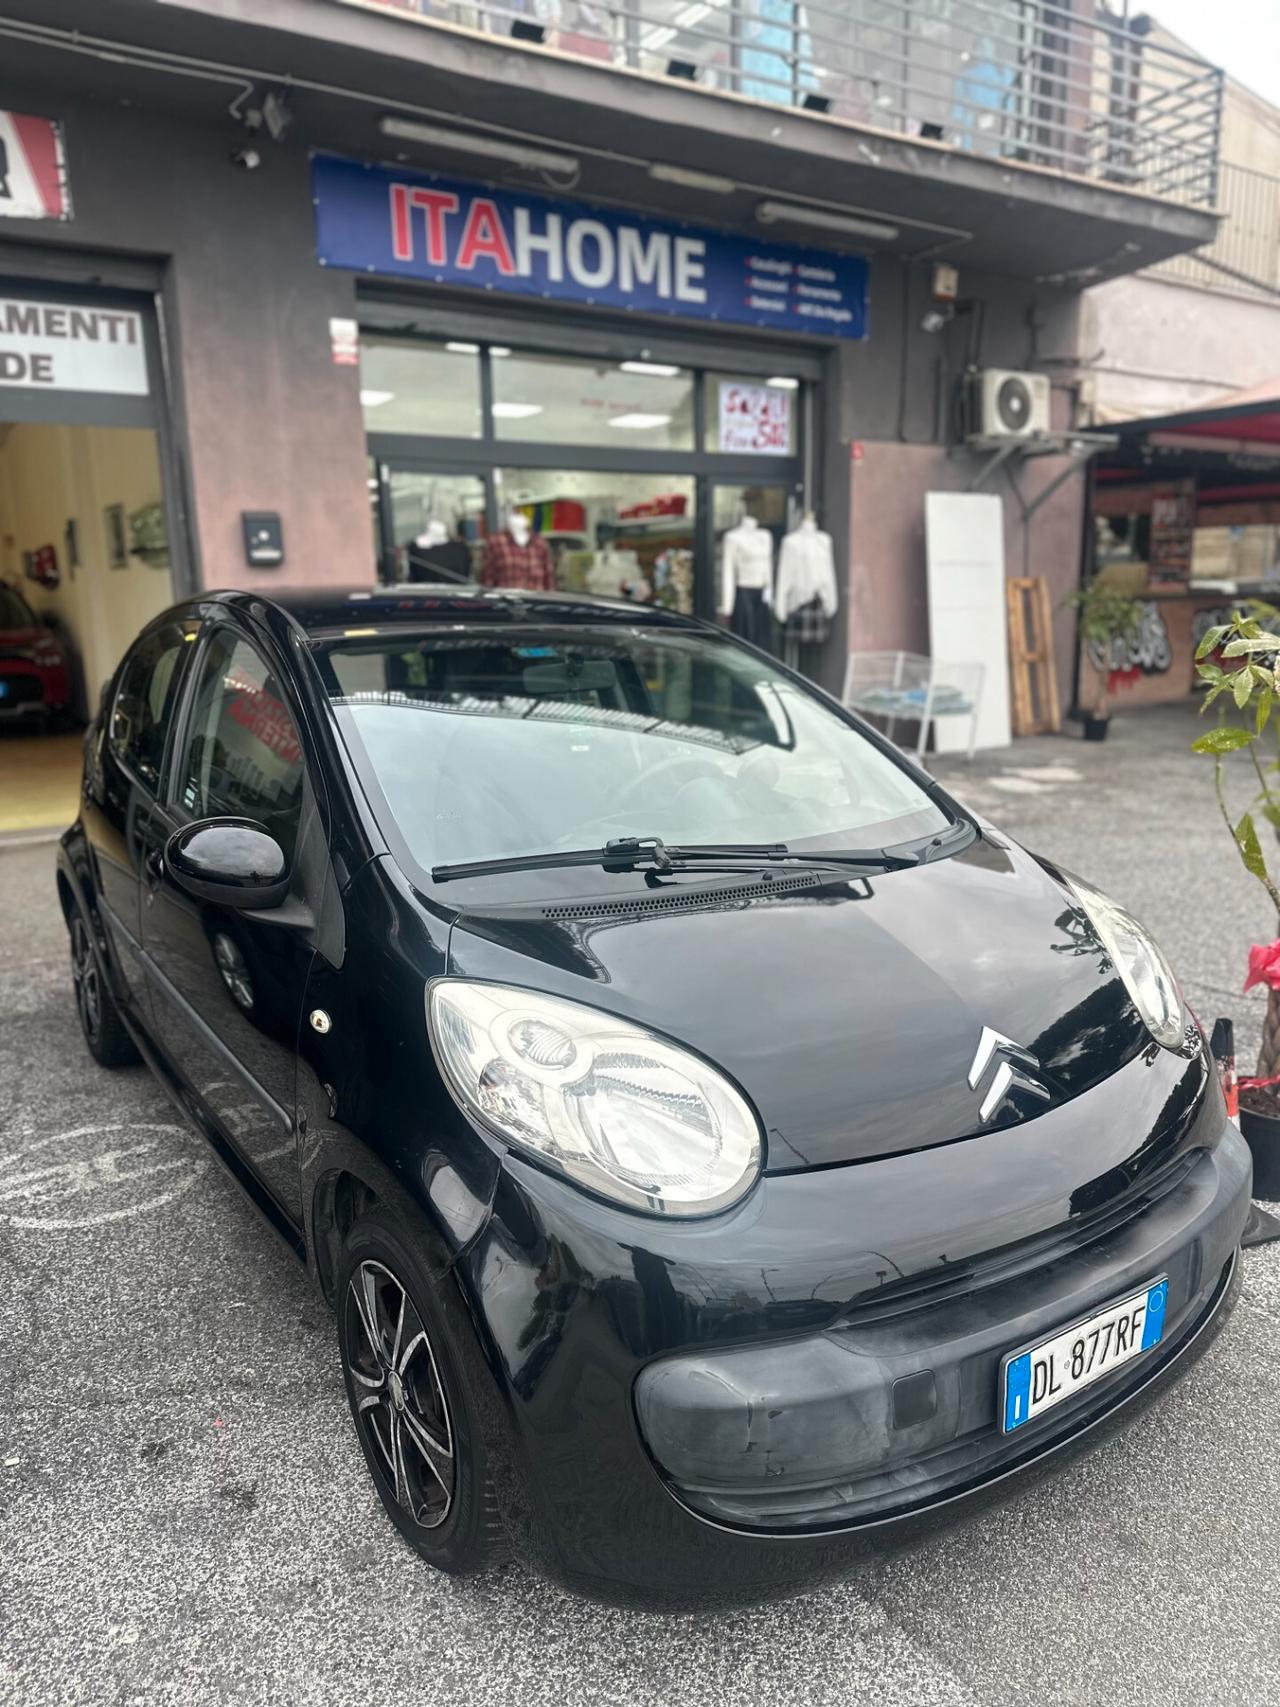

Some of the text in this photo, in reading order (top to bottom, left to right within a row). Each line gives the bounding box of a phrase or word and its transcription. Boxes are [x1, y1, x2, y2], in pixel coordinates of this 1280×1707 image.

[389, 183, 708, 304] ITAHOME
[0, 304, 137, 344] MENTI
[1032, 1305, 1146, 1405] DL 877RF
